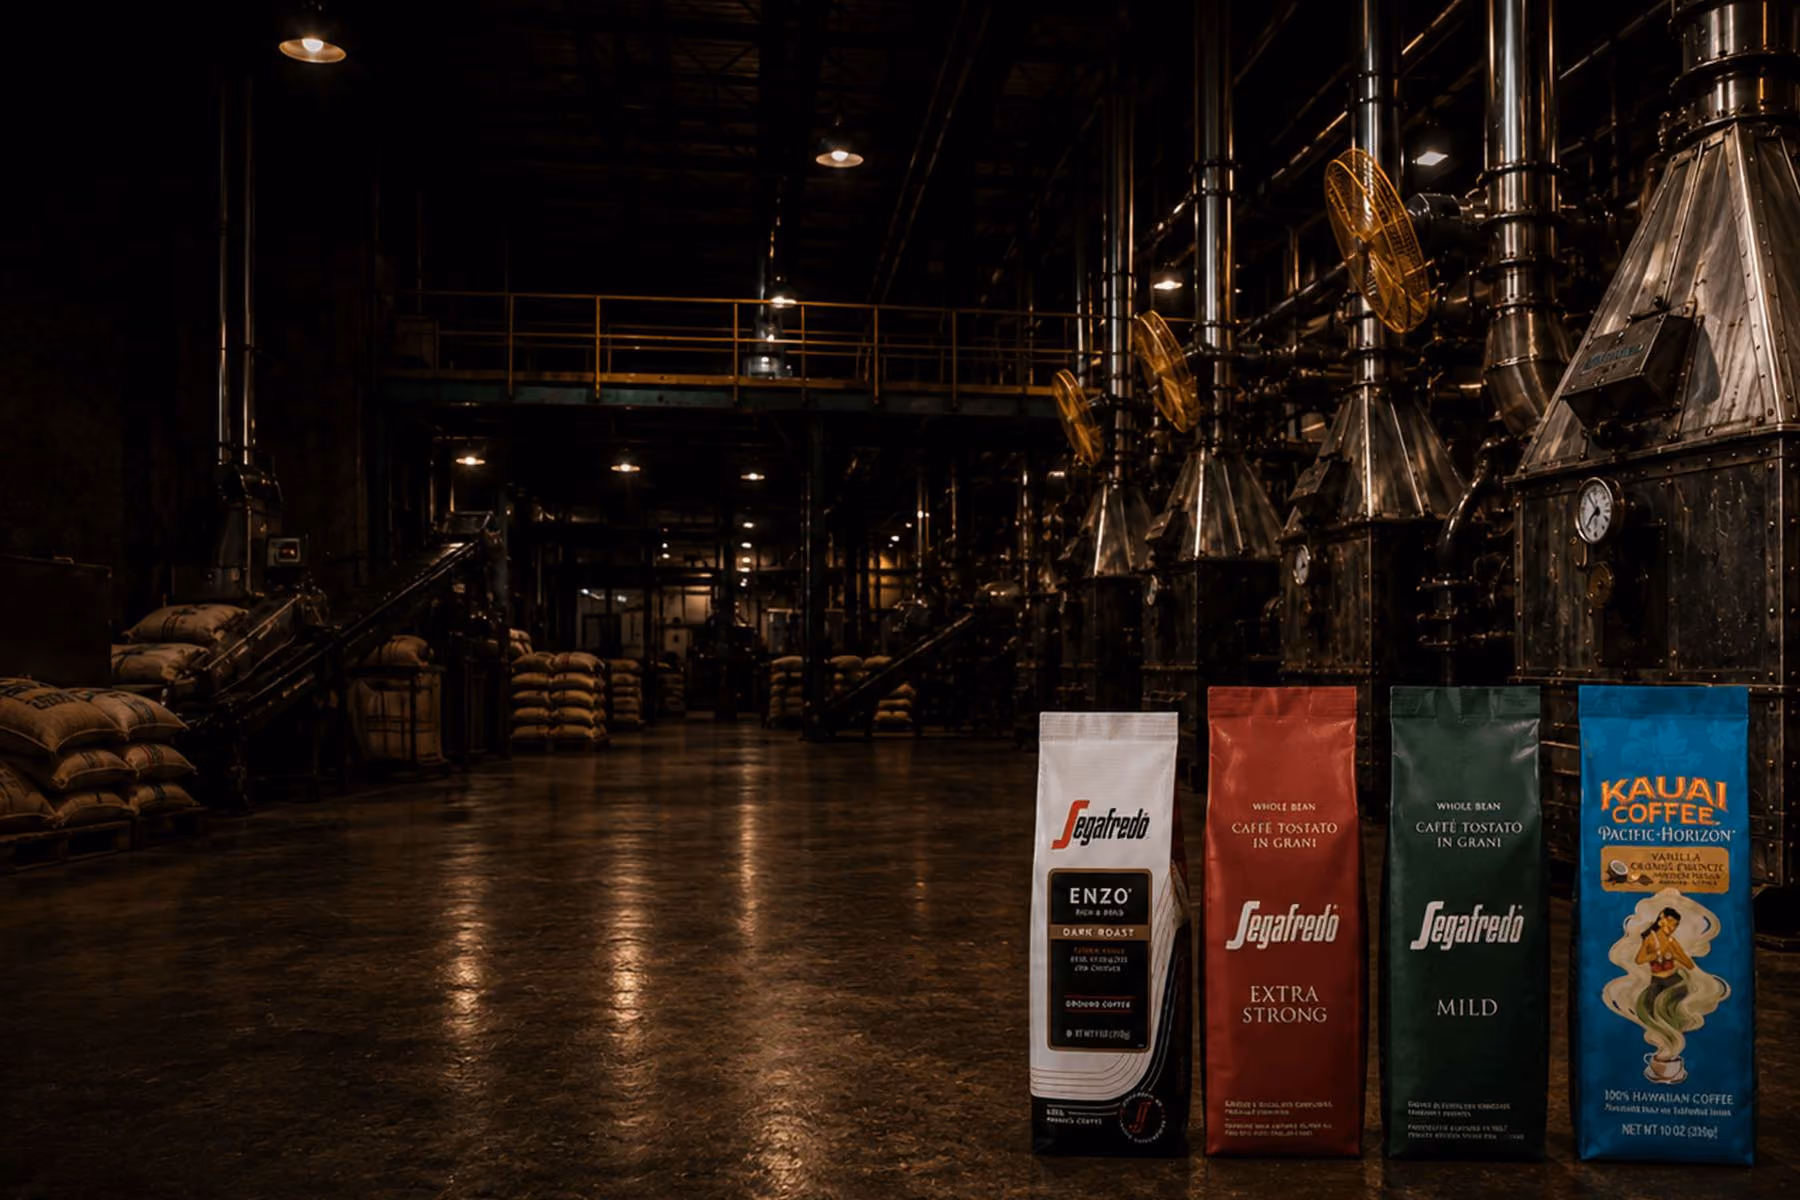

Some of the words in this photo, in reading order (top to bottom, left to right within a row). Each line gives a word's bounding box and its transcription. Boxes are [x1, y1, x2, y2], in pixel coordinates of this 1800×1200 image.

[1601, 776, 1728, 811] KAUAI
[1252, 803, 1287, 811] WHOLE
[1291, 803, 1316, 811] BEAN
[1437, 803, 1472, 811] WHOLE
[1475, 803, 1501, 811] BEAN
[1612, 802, 1716, 825] COFFEE
[1051, 800, 1150, 849] Segafredo
[1278, 823, 1338, 834] TOSTATO
[1462, 822, 1523, 834] TOSTATO
[1661, 826, 1731, 842] HORIZON
[1253, 838, 1269, 849] IN
[1273, 838, 1316, 849] GRANI
[1437, 837, 1452, 848] IN
[1457, 837, 1501, 848] GRANI
[1069, 887, 1128, 905] ENZO
[1062, 928, 1092, 937] DARK
[1097, 928, 1134, 938] ROAST
[1225, 901, 1340, 950] Segafredo
[1410, 901, 1525, 950] Segafredo
[1250, 985, 1319, 1003] EXTRA
[1242, 1006, 1328, 1023] STRONG
[1437, 999, 1498, 1016] MILD
[1632, 1091, 1690, 1104] HAWAIIAN
[1693, 1093, 1734, 1105] COFFEE
[1621, 1123, 1642, 1136] NET
